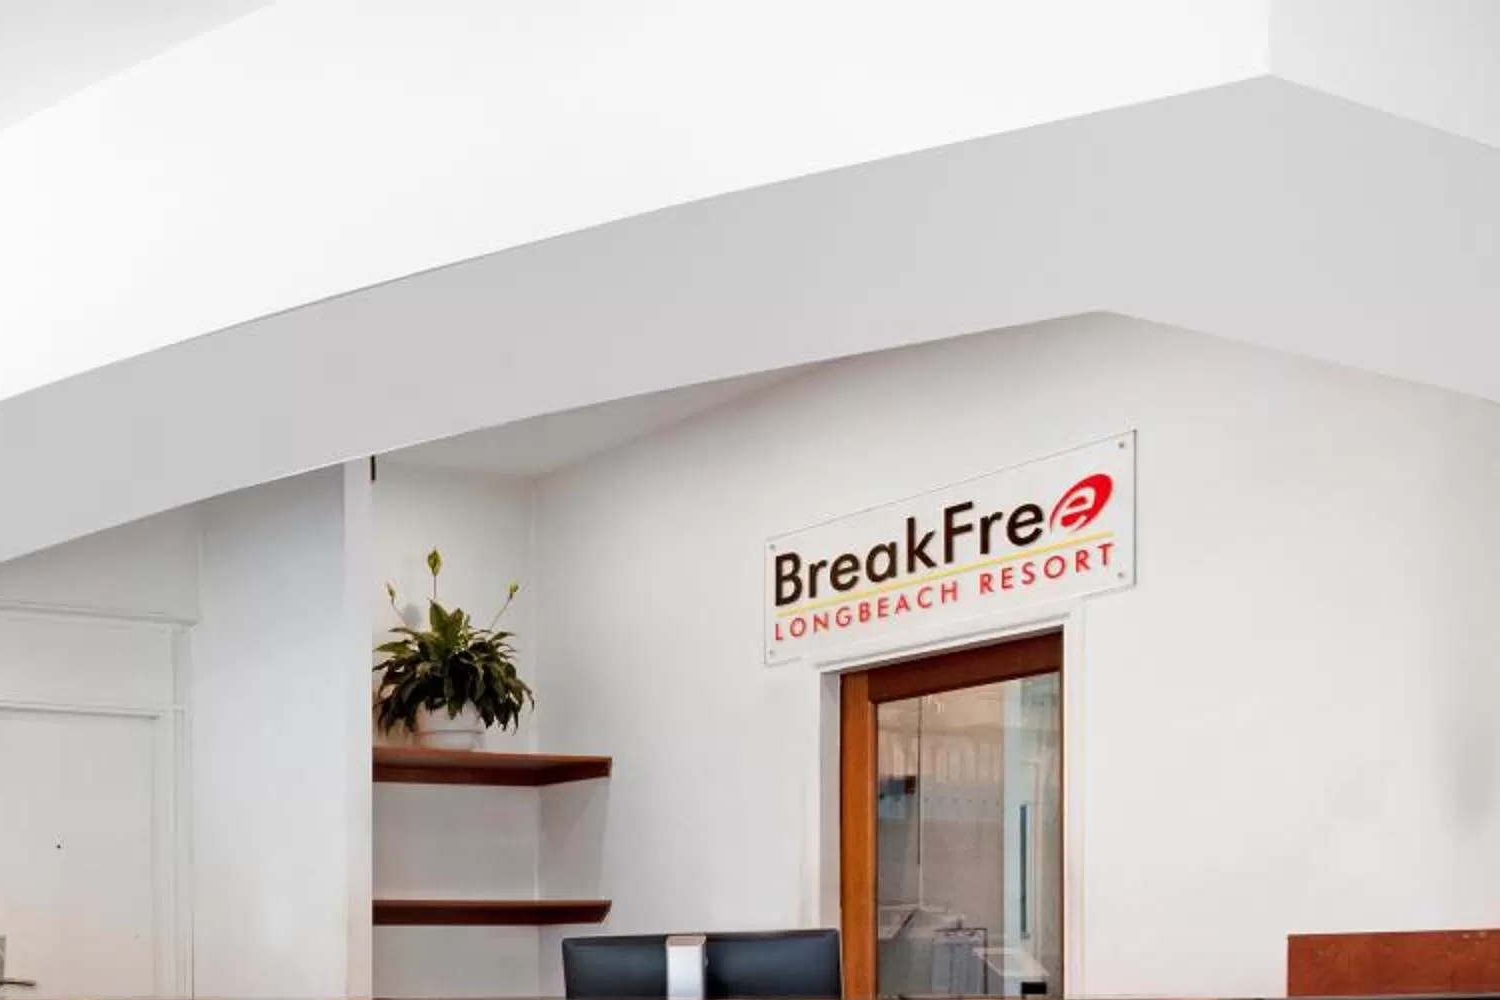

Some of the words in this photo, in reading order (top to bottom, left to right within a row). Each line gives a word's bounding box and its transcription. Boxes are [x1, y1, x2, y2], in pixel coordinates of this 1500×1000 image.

[774, 473, 1114, 607] BreakFree
[774, 581, 959, 641] LONGBEACH
[979, 543, 1115, 594] RESORT
